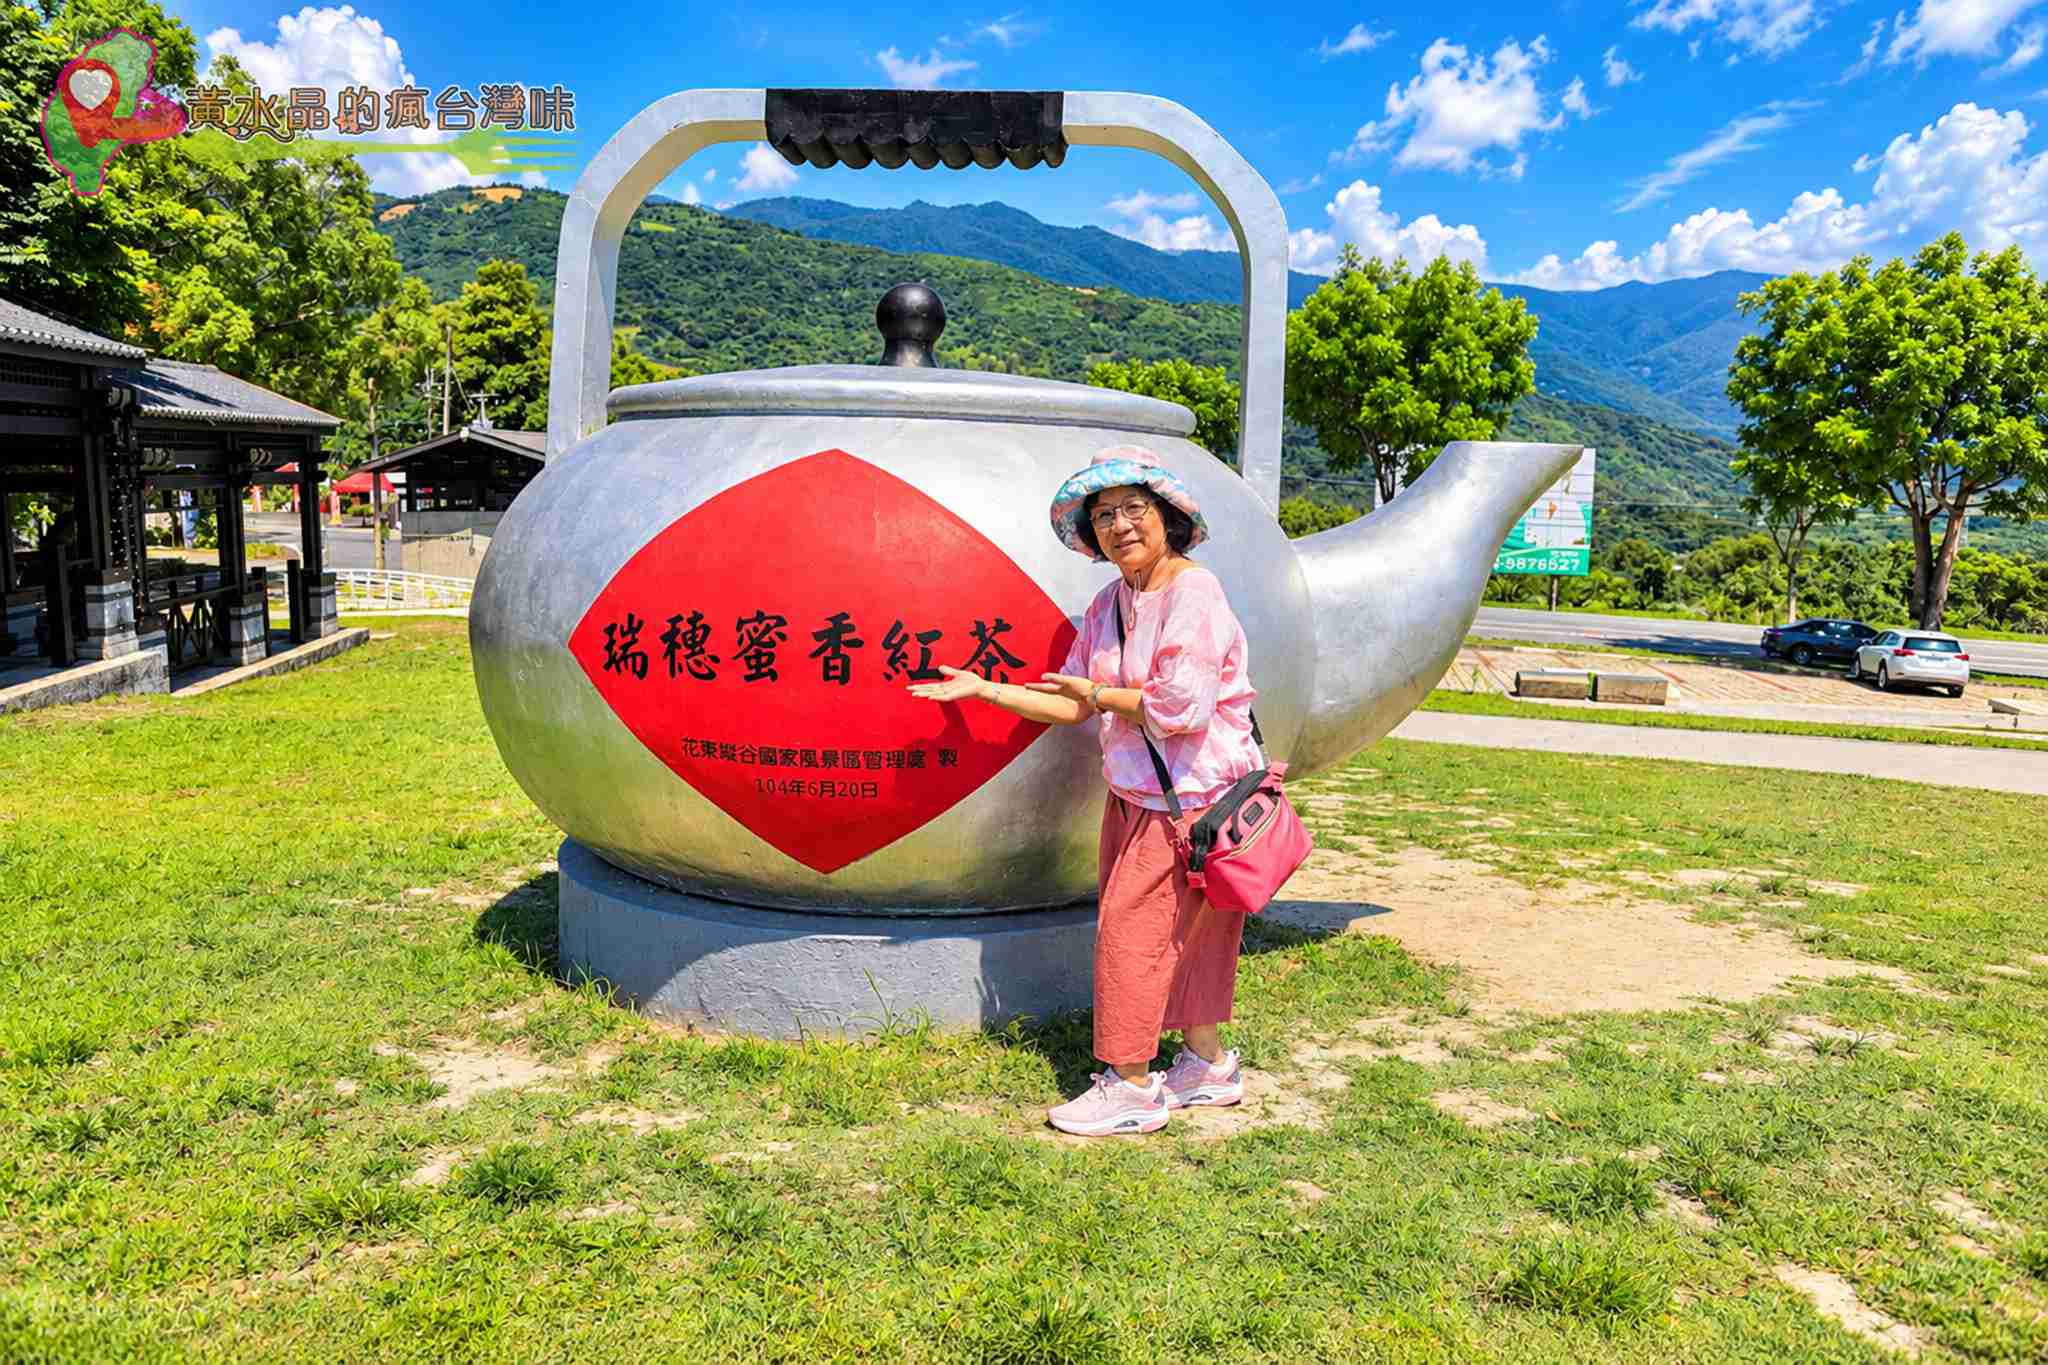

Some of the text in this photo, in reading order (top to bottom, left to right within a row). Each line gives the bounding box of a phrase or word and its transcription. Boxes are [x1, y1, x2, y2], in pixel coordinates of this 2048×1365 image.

[602, 610, 1028, 686] 瑞穗蜜香紅茶
[681, 737, 926, 769] 花東縱谷國家風景區管理處
[755, 778, 878, 798] 104年6月20日
